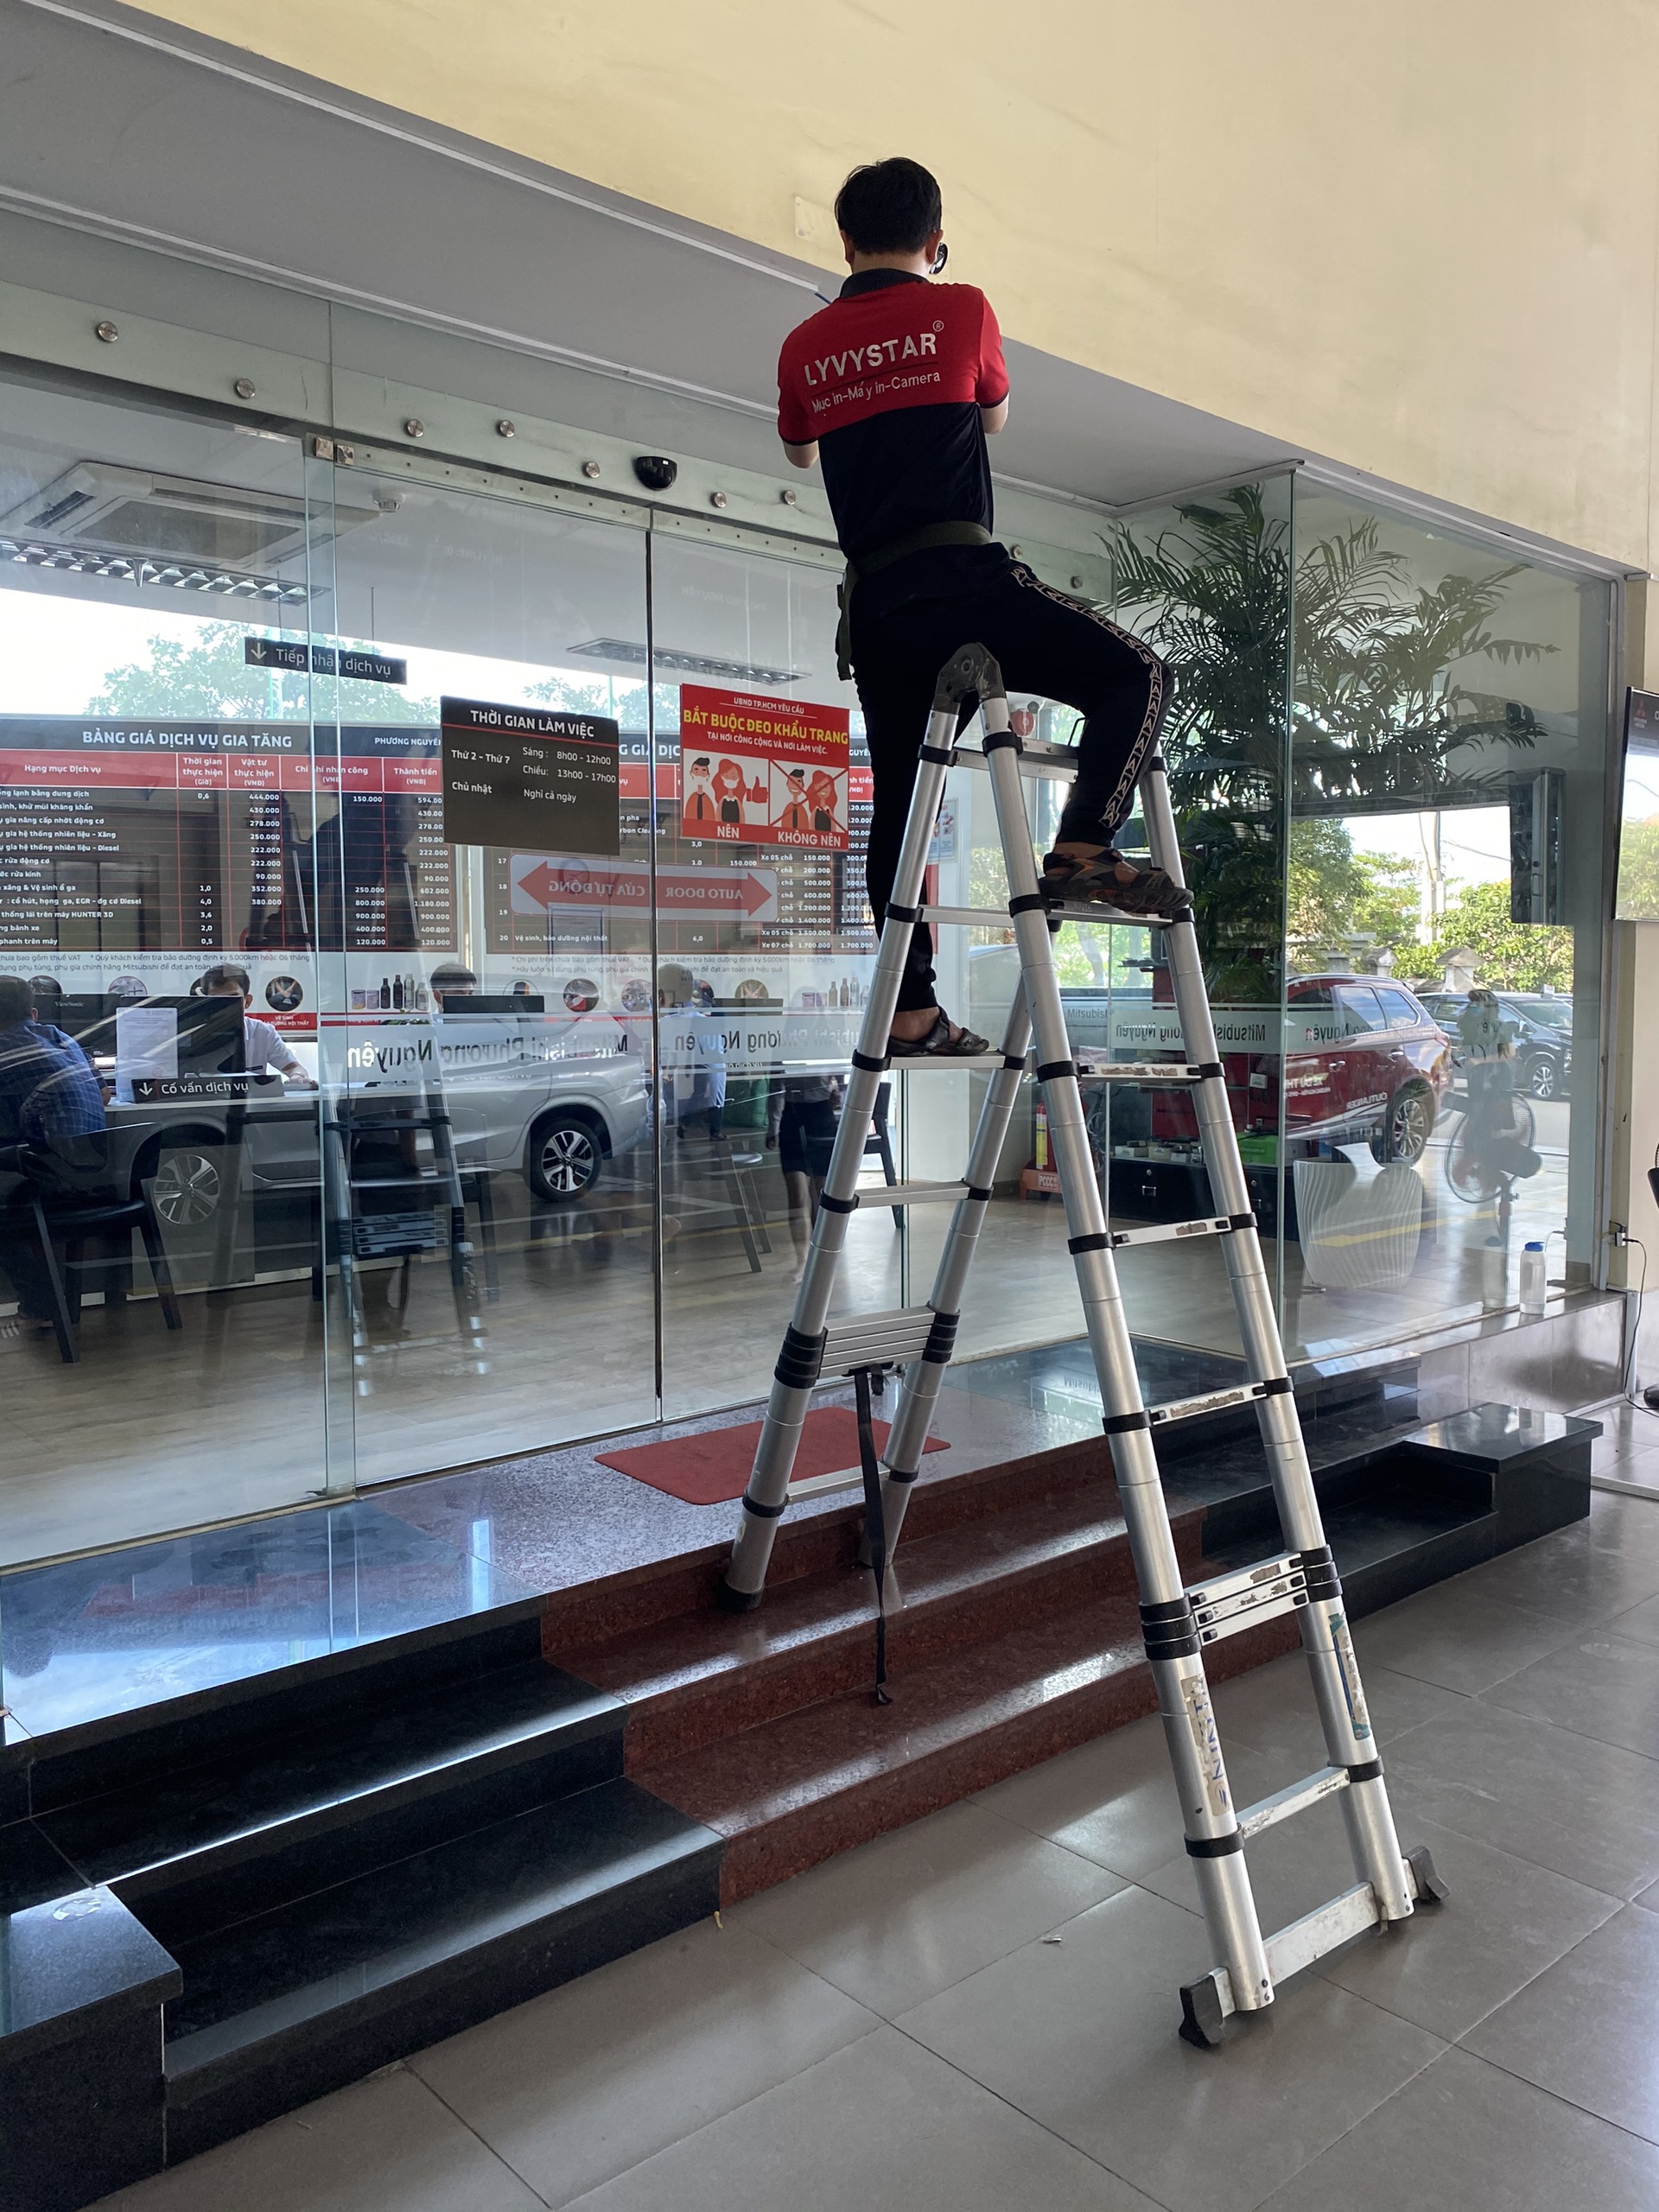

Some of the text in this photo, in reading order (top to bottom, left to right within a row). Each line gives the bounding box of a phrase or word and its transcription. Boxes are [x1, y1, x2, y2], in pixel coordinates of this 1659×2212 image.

[804, 334, 937, 385] LYVYSTAR
[875, 372, 941, 394] in-Camera
[276, 648, 304, 666] Tiếp
[346, 658, 372, 673] dịch
[376, 664, 391, 677] vụ
[734, 696, 804, 715] UBND TP.HCM YÊU CẦU
[470, 709, 594, 739] THỜI GIAN LÀM VIỆC
[683, 706, 849, 745] BẮT BUỘC ĐEO KHẨU TRANG
[83, 728, 292, 749] BẢNG GIÁ DỊCH VỤ GIA TĂNG
[375, 737, 410, 746] PHƯƠNG
[707, 731, 829, 756] TẠI NƠI CÔNG CỘNG VÀ NƠI LÀM VIỆC.
[451, 749, 469, 760] Thứ
[471, 752, 477, 760] 2
[486, 753, 503, 763] Thứ
[523, 747, 543, 758] Sáng
[556, 752, 611, 765] 8h00 12h00
[24, 764, 47, 775] Hạng
[48, 766, 67, 774] mục
[91, 766, 101, 775] vụ
[242, 759, 256, 768] Vật
[205, 768, 223, 778] hiện
[256, 769, 275, 779] hiện
[347, 766, 368, 776] công
[422, 767, 437, 776] tiền
[524, 766, 549, 776] Chiều:
[558, 769, 616, 783] 13h00 17h00
[453, 781, 493, 794] Chủ nhật
[524, 789, 577, 804] Nghỉ cả ngày
[717, 823, 740, 839] NÊN
[778, 830, 842, 848] KHÔNG NÊN
[30, 843, 53, 852] thống
[40, 898, 59, 906] họng
[54, 911, 70, 919] máy
[557, 934, 579, 943] dưỡng
[594, 933, 608, 942] thất
[162, 1082, 249, 1095] Cố vấn dịch vụ
